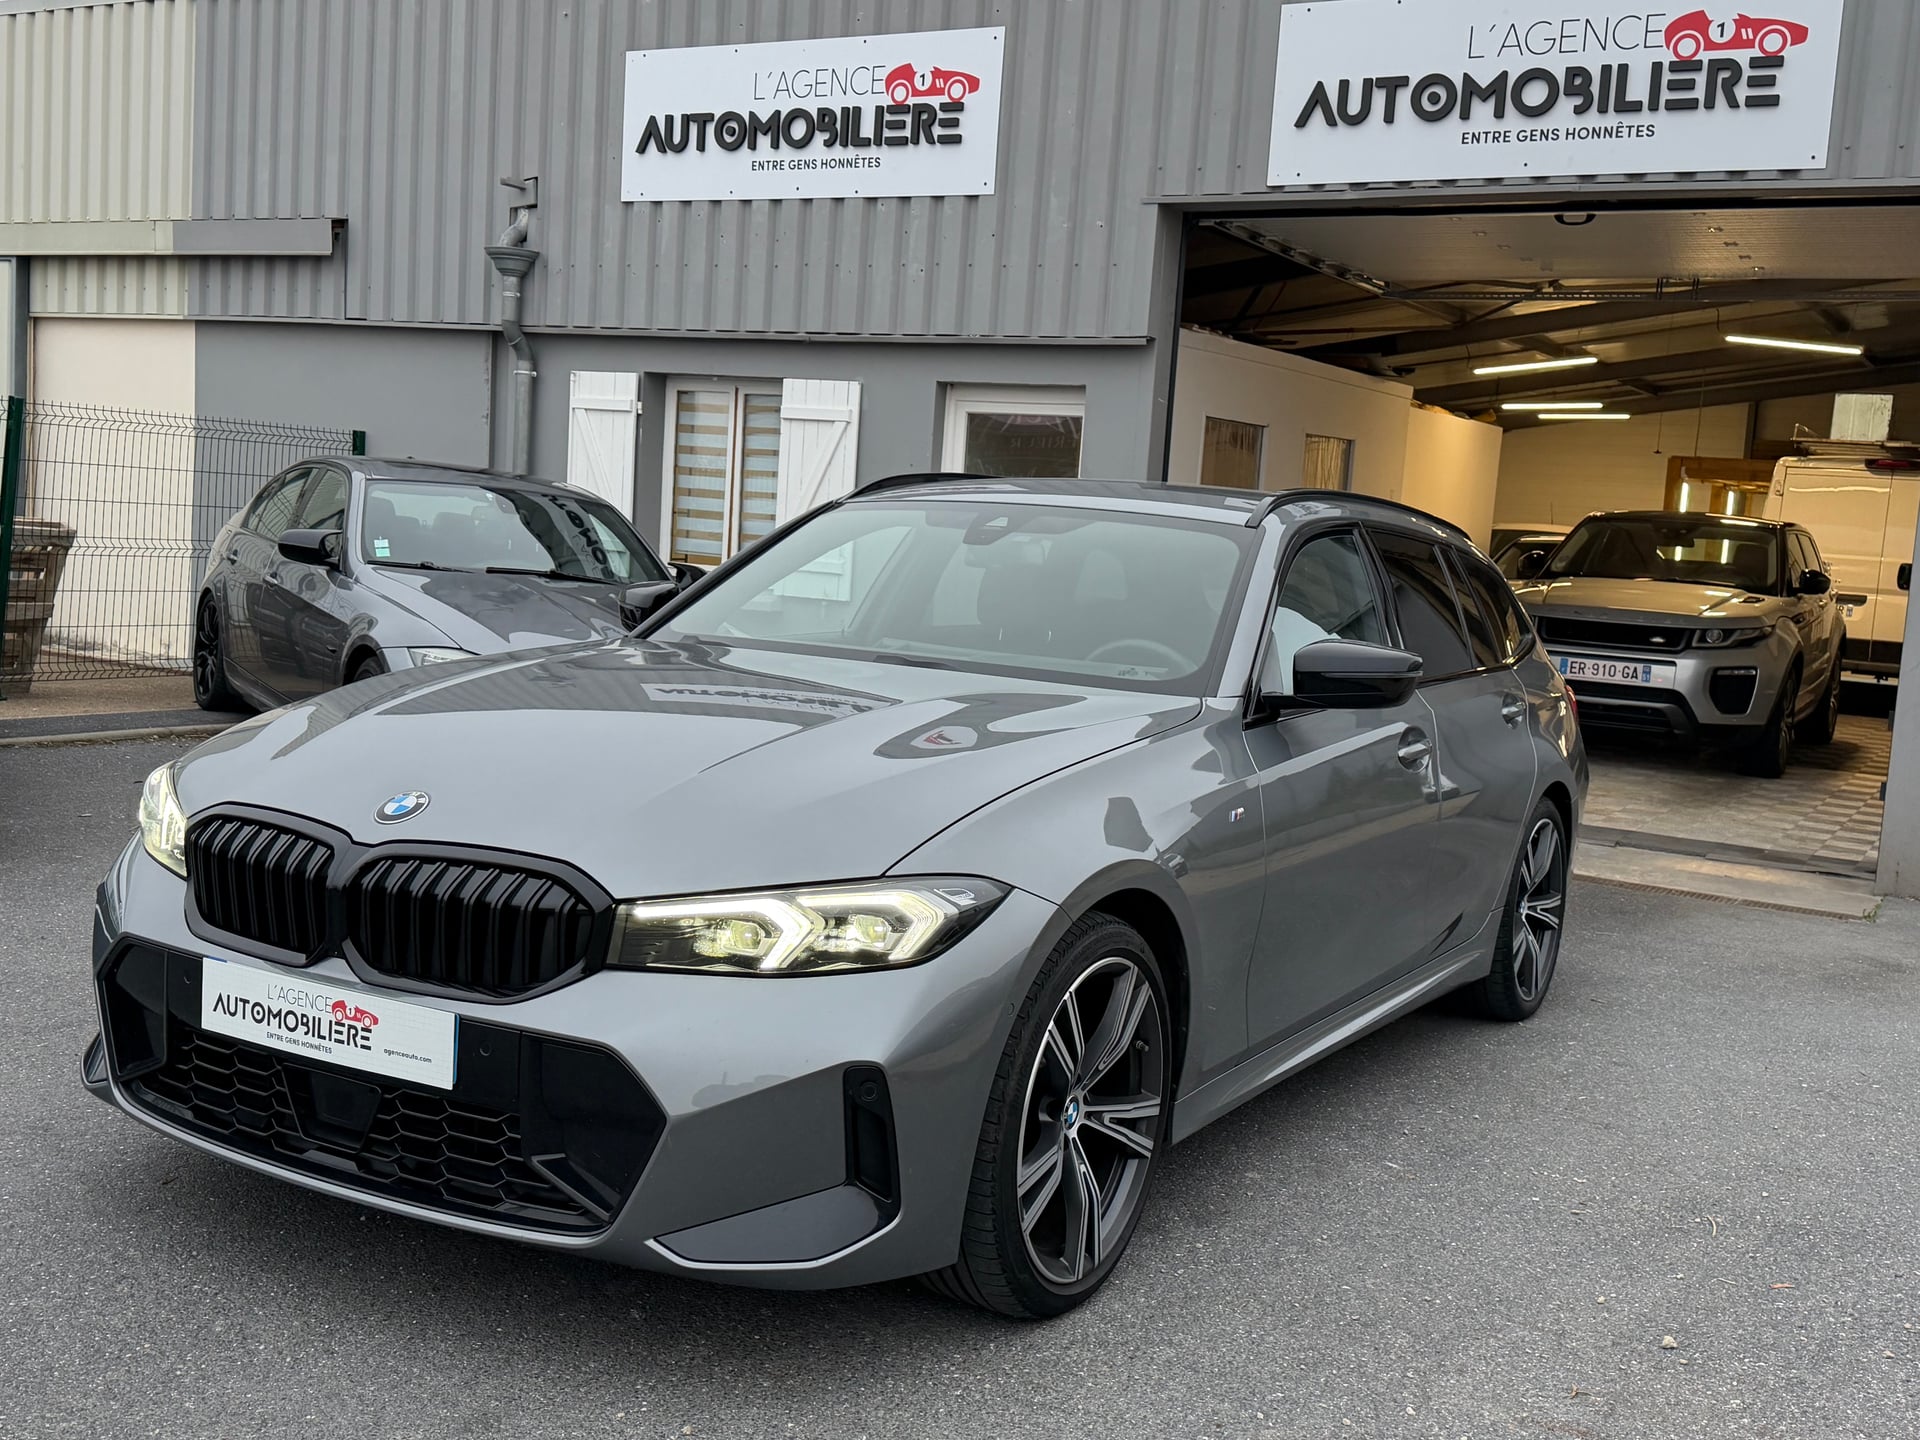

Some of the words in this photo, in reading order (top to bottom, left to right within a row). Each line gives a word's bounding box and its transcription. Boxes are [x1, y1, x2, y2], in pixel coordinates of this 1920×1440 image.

[1468, 13, 1666, 59] L'AGENCE
[1716, 21, 1726, 38] 1
[753, 65, 886, 101] L'AGENCE
[919, 74, 926, 87] 1
[1461, 129, 1511, 145] ENTRE
[1516, 127, 1560, 143] GENS
[1565, 121, 1656, 141] HONNÊTES
[751, 159, 785, 171] ENTRE
[788, 158, 817, 170] GENS
[820, 154, 881, 169] HONNÊTES
[267, 984, 333, 1013] L'AGENCE
[267, 1031, 284, 1043] ENTRE
[285, 1036, 300, 1047] GENS
[301, 1039, 333, 1054] HONNÊTES
[383, 1048, 432, 1064] agenceauto.com
